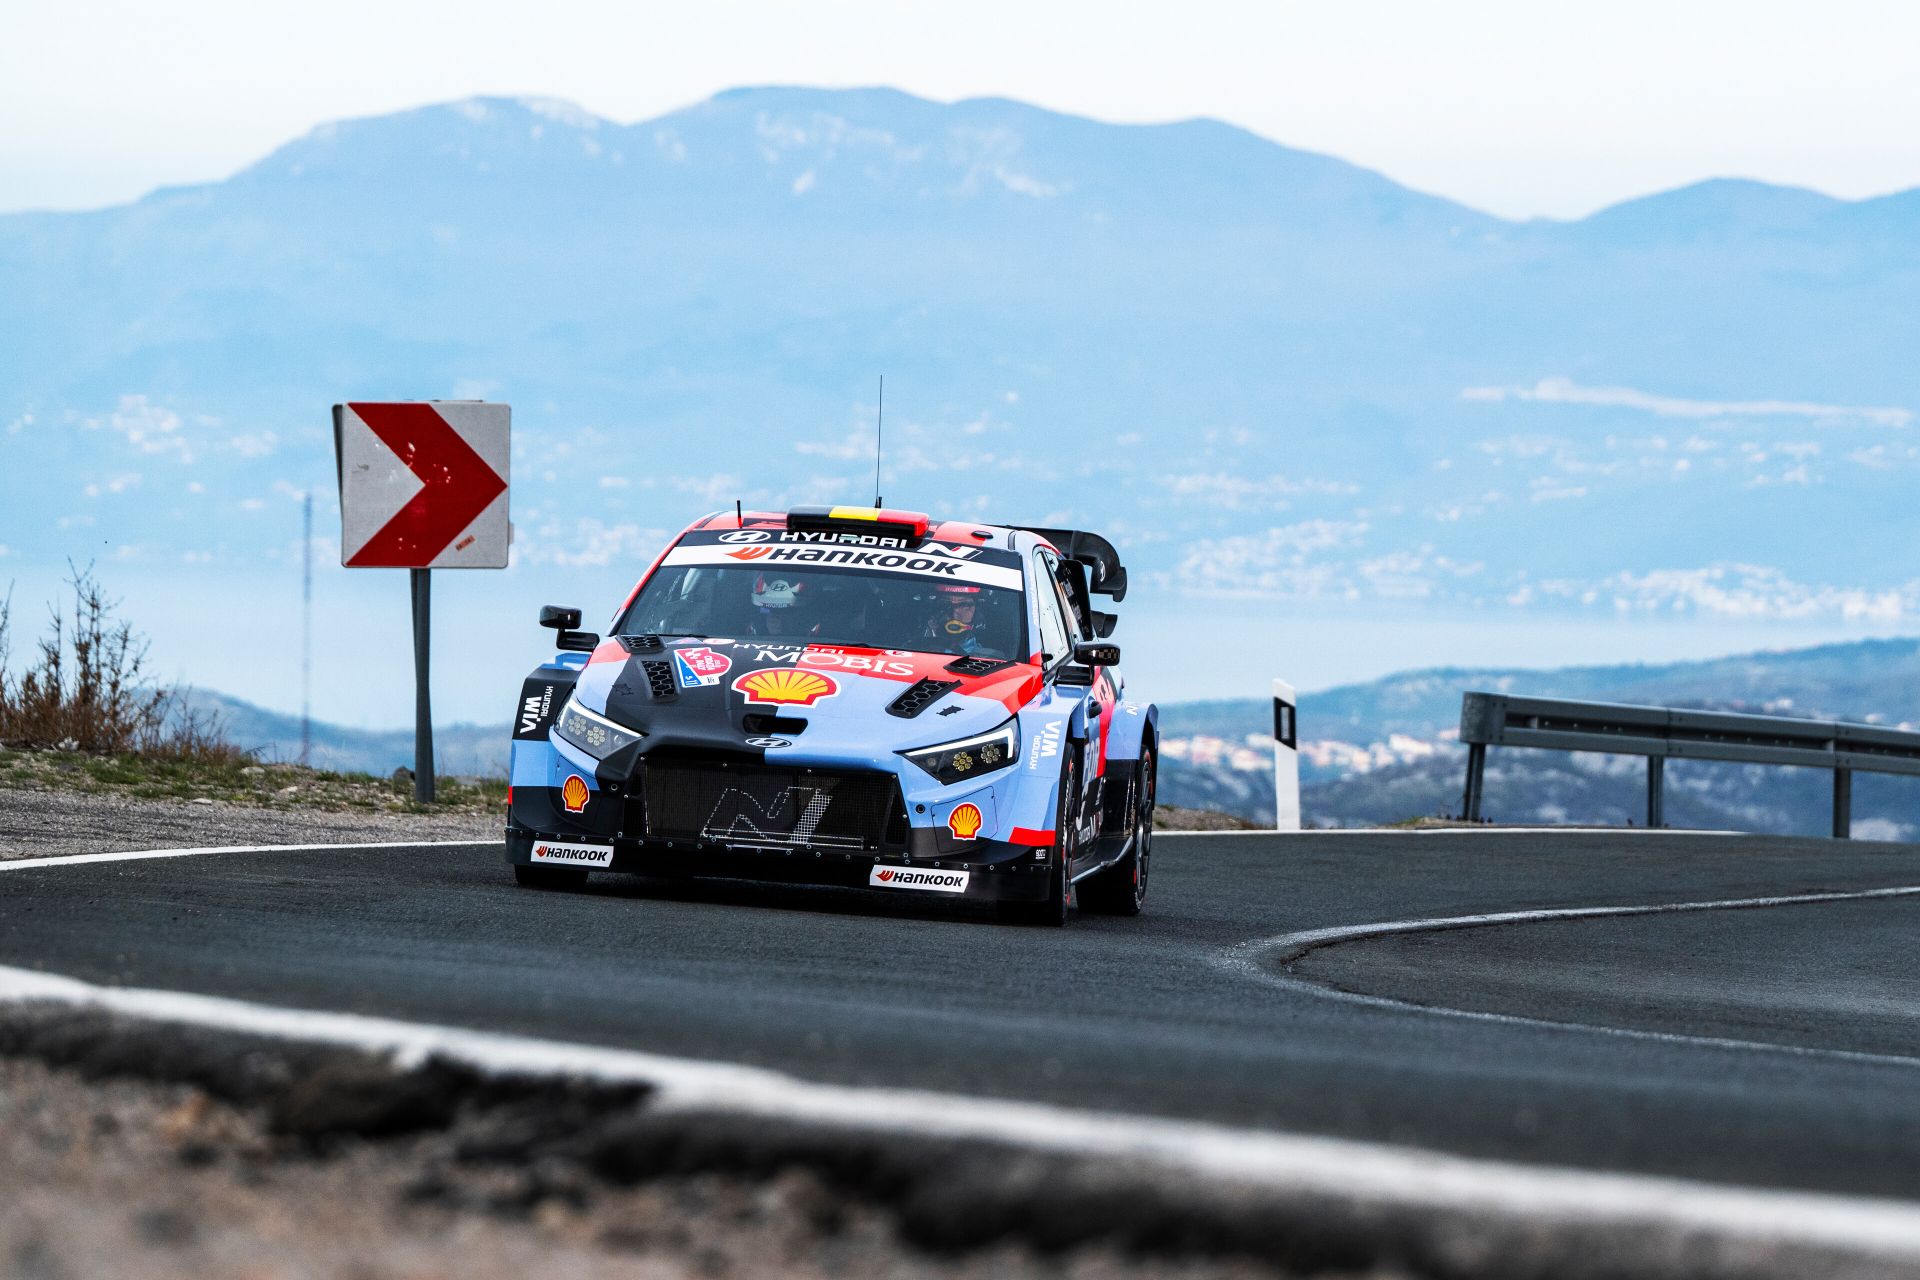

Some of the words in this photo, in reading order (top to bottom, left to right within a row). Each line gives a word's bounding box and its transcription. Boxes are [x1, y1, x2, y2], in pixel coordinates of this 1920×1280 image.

[780, 531, 907, 549] HYUNDAI
[732, 643, 844, 655] HYUNDAI
[754, 650, 914, 676] MOBIS
[540, 685, 554, 717] HYUNDAI
[1029, 735, 1042, 770] HYUNDAI
